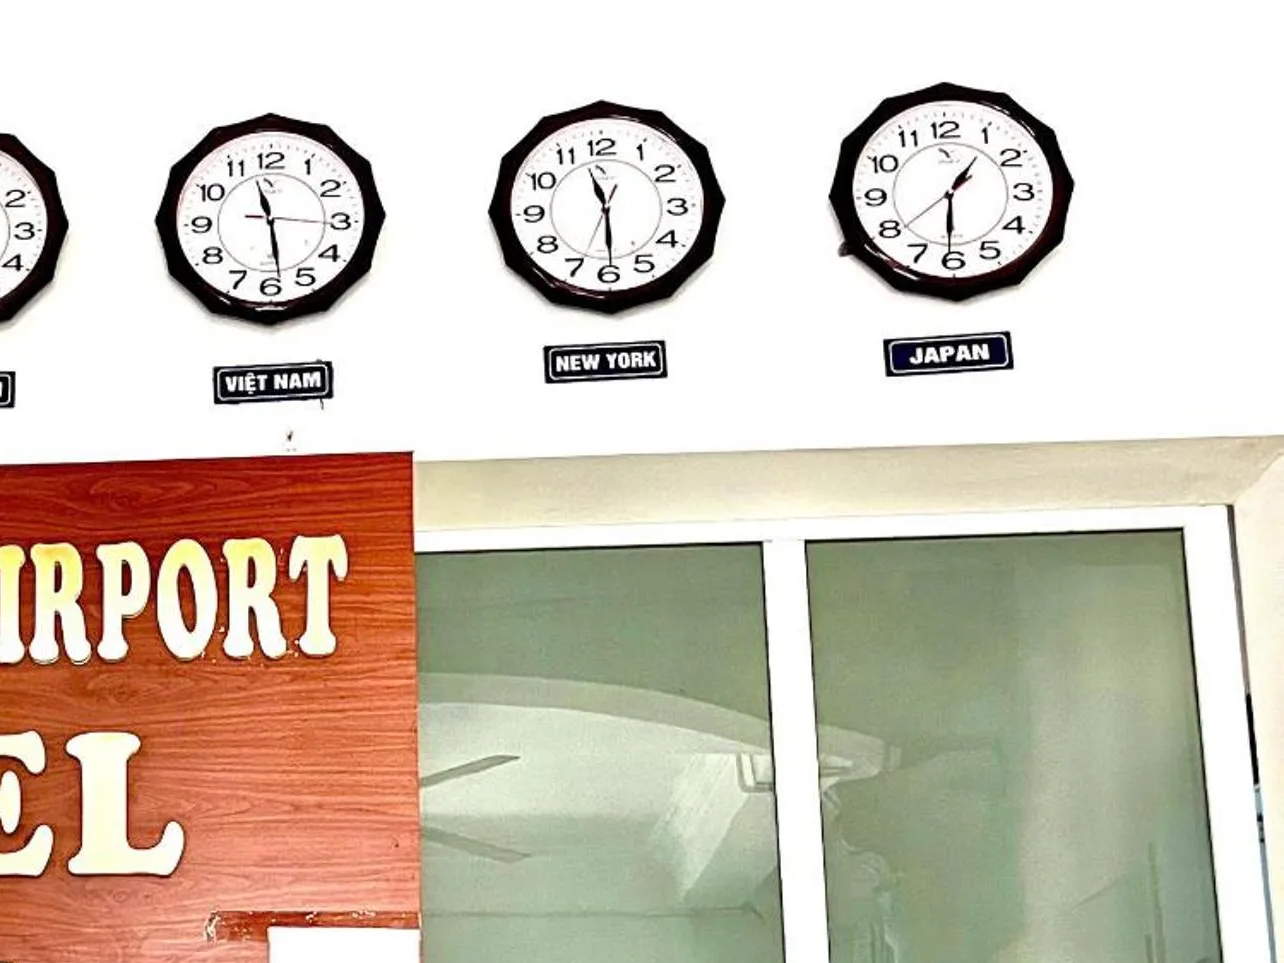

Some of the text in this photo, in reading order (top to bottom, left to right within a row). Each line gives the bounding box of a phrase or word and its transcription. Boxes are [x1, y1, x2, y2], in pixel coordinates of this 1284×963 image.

[898, 129, 918, 148] 11
[930, 120, 961, 139] 12
[981, 127, 989, 145] 1
[556, 147, 575, 165] 11
[587, 137, 617, 157] 12
[636, 143, 644, 161] 1
[227, 159, 245, 177] 11
[257, 151, 285, 170] 12
[304, 158, 311, 176] 1
[871, 154, 899, 174] 10
[999, 148, 1023, 168] 2
[530, 171, 557, 191] 10
[654, 164, 676, 183] 2
[4, 189, 26, 208] 2
[199, 183, 226, 202] 10
[319, 179, 342, 198] 2
[864, 187, 888, 207] 9
[1013, 182, 1035, 202] 3
[523, 204, 546, 224] 9
[666, 197, 689, 217] 3
[14, 221, 36, 241] 3
[191, 215, 213, 234] 9
[329, 212, 352, 231] 3
[878, 220, 902, 239] 8
[1001, 215, 1026, 235] 4
[536, 235, 559, 254] 8
[655, 229, 679, 249] 4
[202, 246, 224, 265] 8
[317, 244, 341, 263] 4
[907, 243, 929, 264] 7
[979, 240, 1001, 260] 5
[1, 253, 24, 272] 4
[564, 257, 585, 278] 7
[633, 254, 656, 274] 5
[941, 251, 966, 271] 6
[228, 269, 248, 290] 7
[294, 267, 316, 287] 5
[597, 265, 621, 284] 6
[259, 277, 282, 297] 6
[555, 350, 657, 373] NEW YORK
[909, 343, 990, 365] JAPAN
[225, 371, 321, 395] VIỆT NAM
